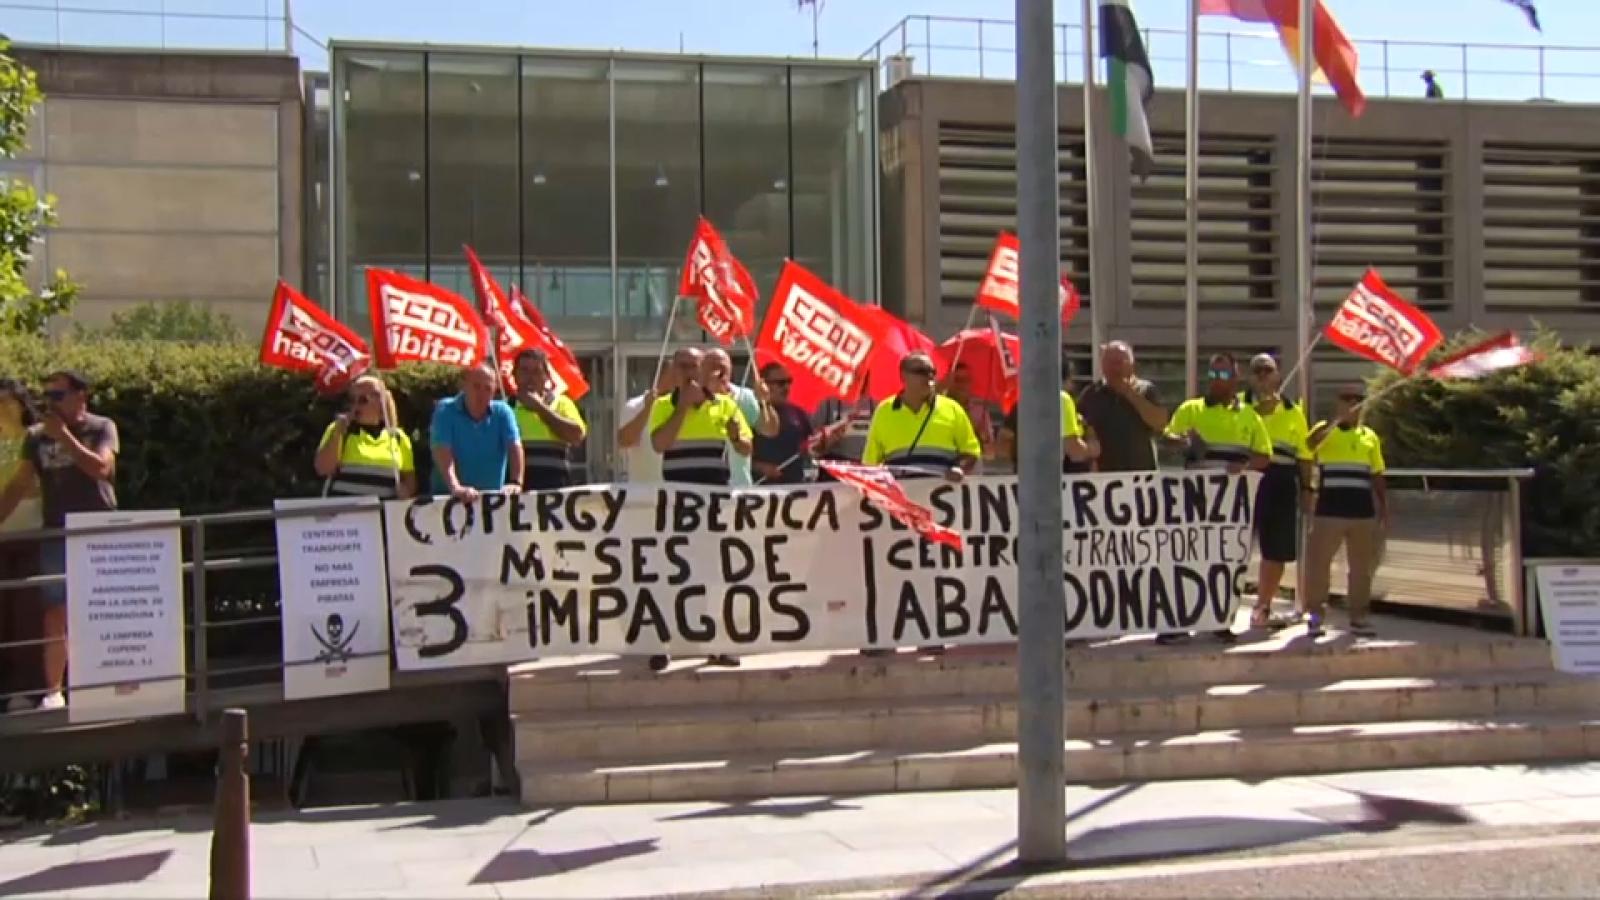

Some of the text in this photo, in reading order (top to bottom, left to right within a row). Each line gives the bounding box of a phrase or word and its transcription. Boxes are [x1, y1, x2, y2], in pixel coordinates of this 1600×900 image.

[788, 291, 865, 361] CCOO
[404, 490, 627, 545] COPERGY
[655, 489, 840, 533] IBERICA
[930, 474, 1250, 532] SINRGÜENZA
[500, 535, 793, 585] MESES DE
[1073, 526, 1249, 566] TRANSPORTES
[409, 565, 468, 658] 3
